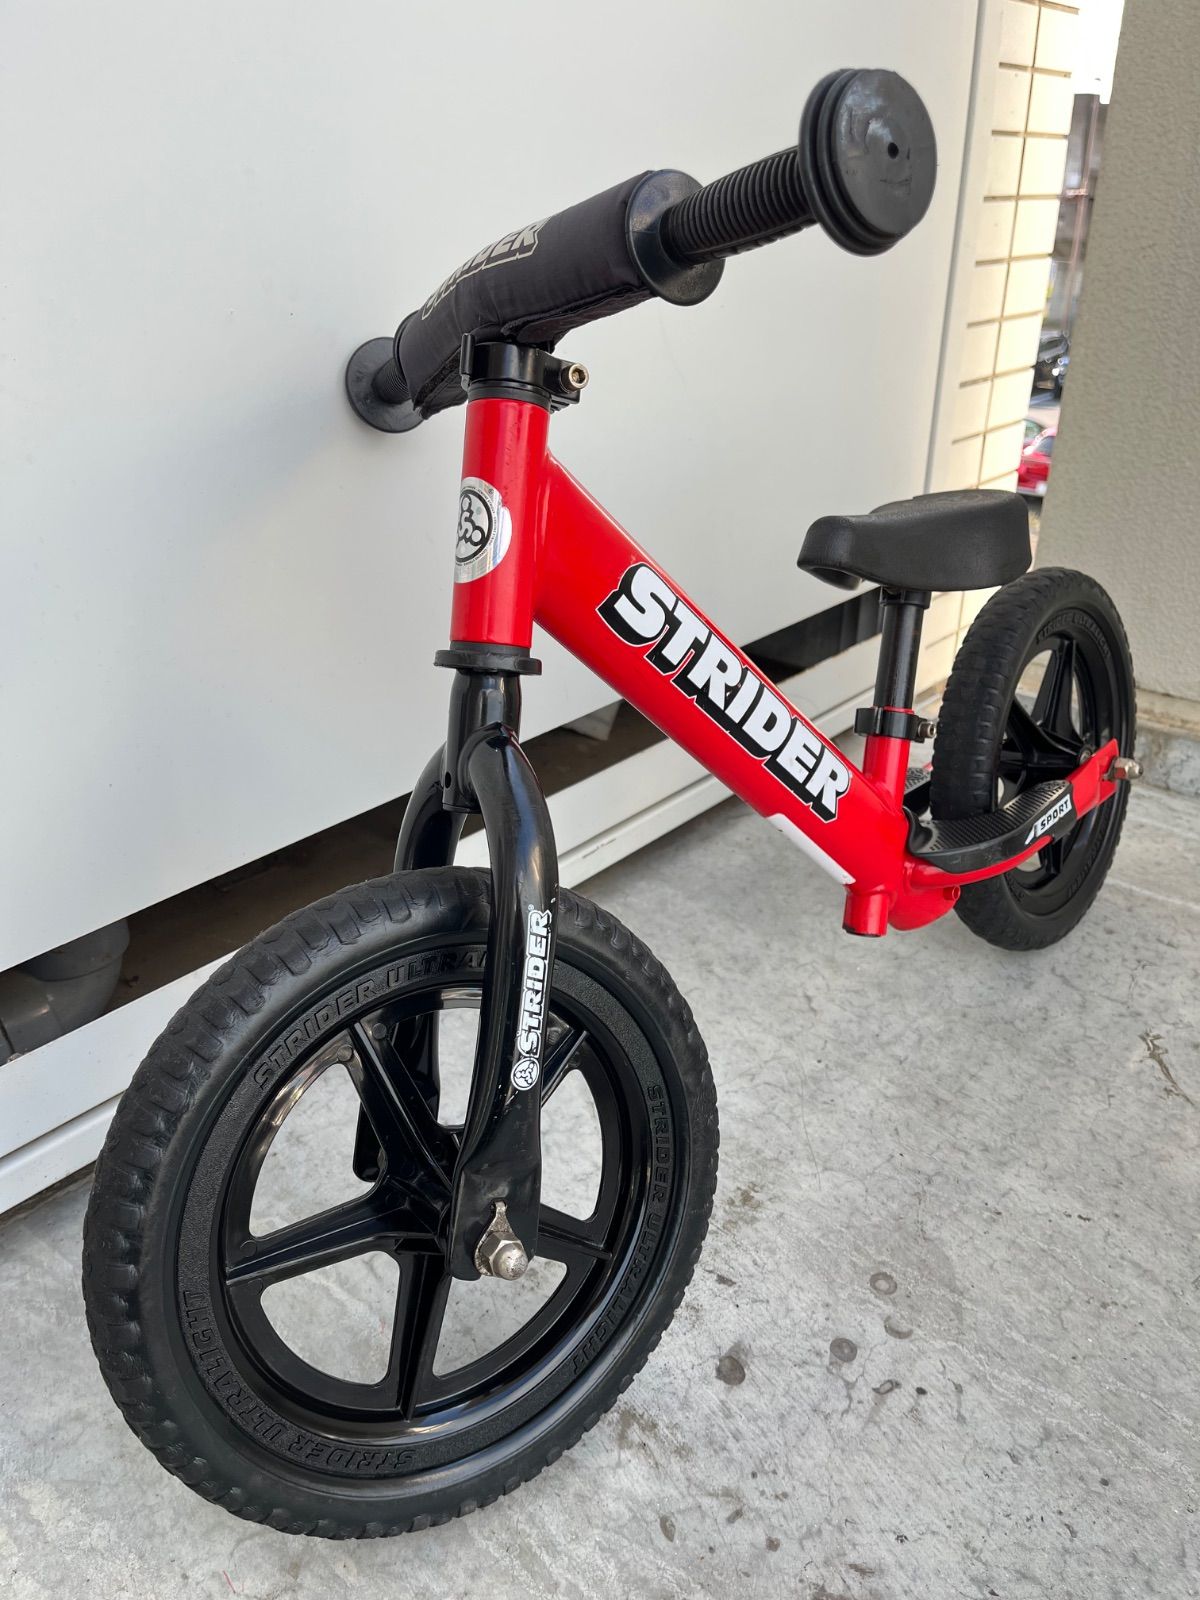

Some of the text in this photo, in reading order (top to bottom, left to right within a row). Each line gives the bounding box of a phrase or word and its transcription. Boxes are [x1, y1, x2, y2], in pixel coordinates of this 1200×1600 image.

[598, 562, 851, 822] STRIDER
[1040, 799, 1070, 831] SPORT
[253, 978, 377, 1090] STRIDER
[518, 909, 552, 1058] STRIDER
[646, 1083, 672, 1203] STRIDER
[182, 1289, 416, 1470] STRIDER ULTRALIGHT
